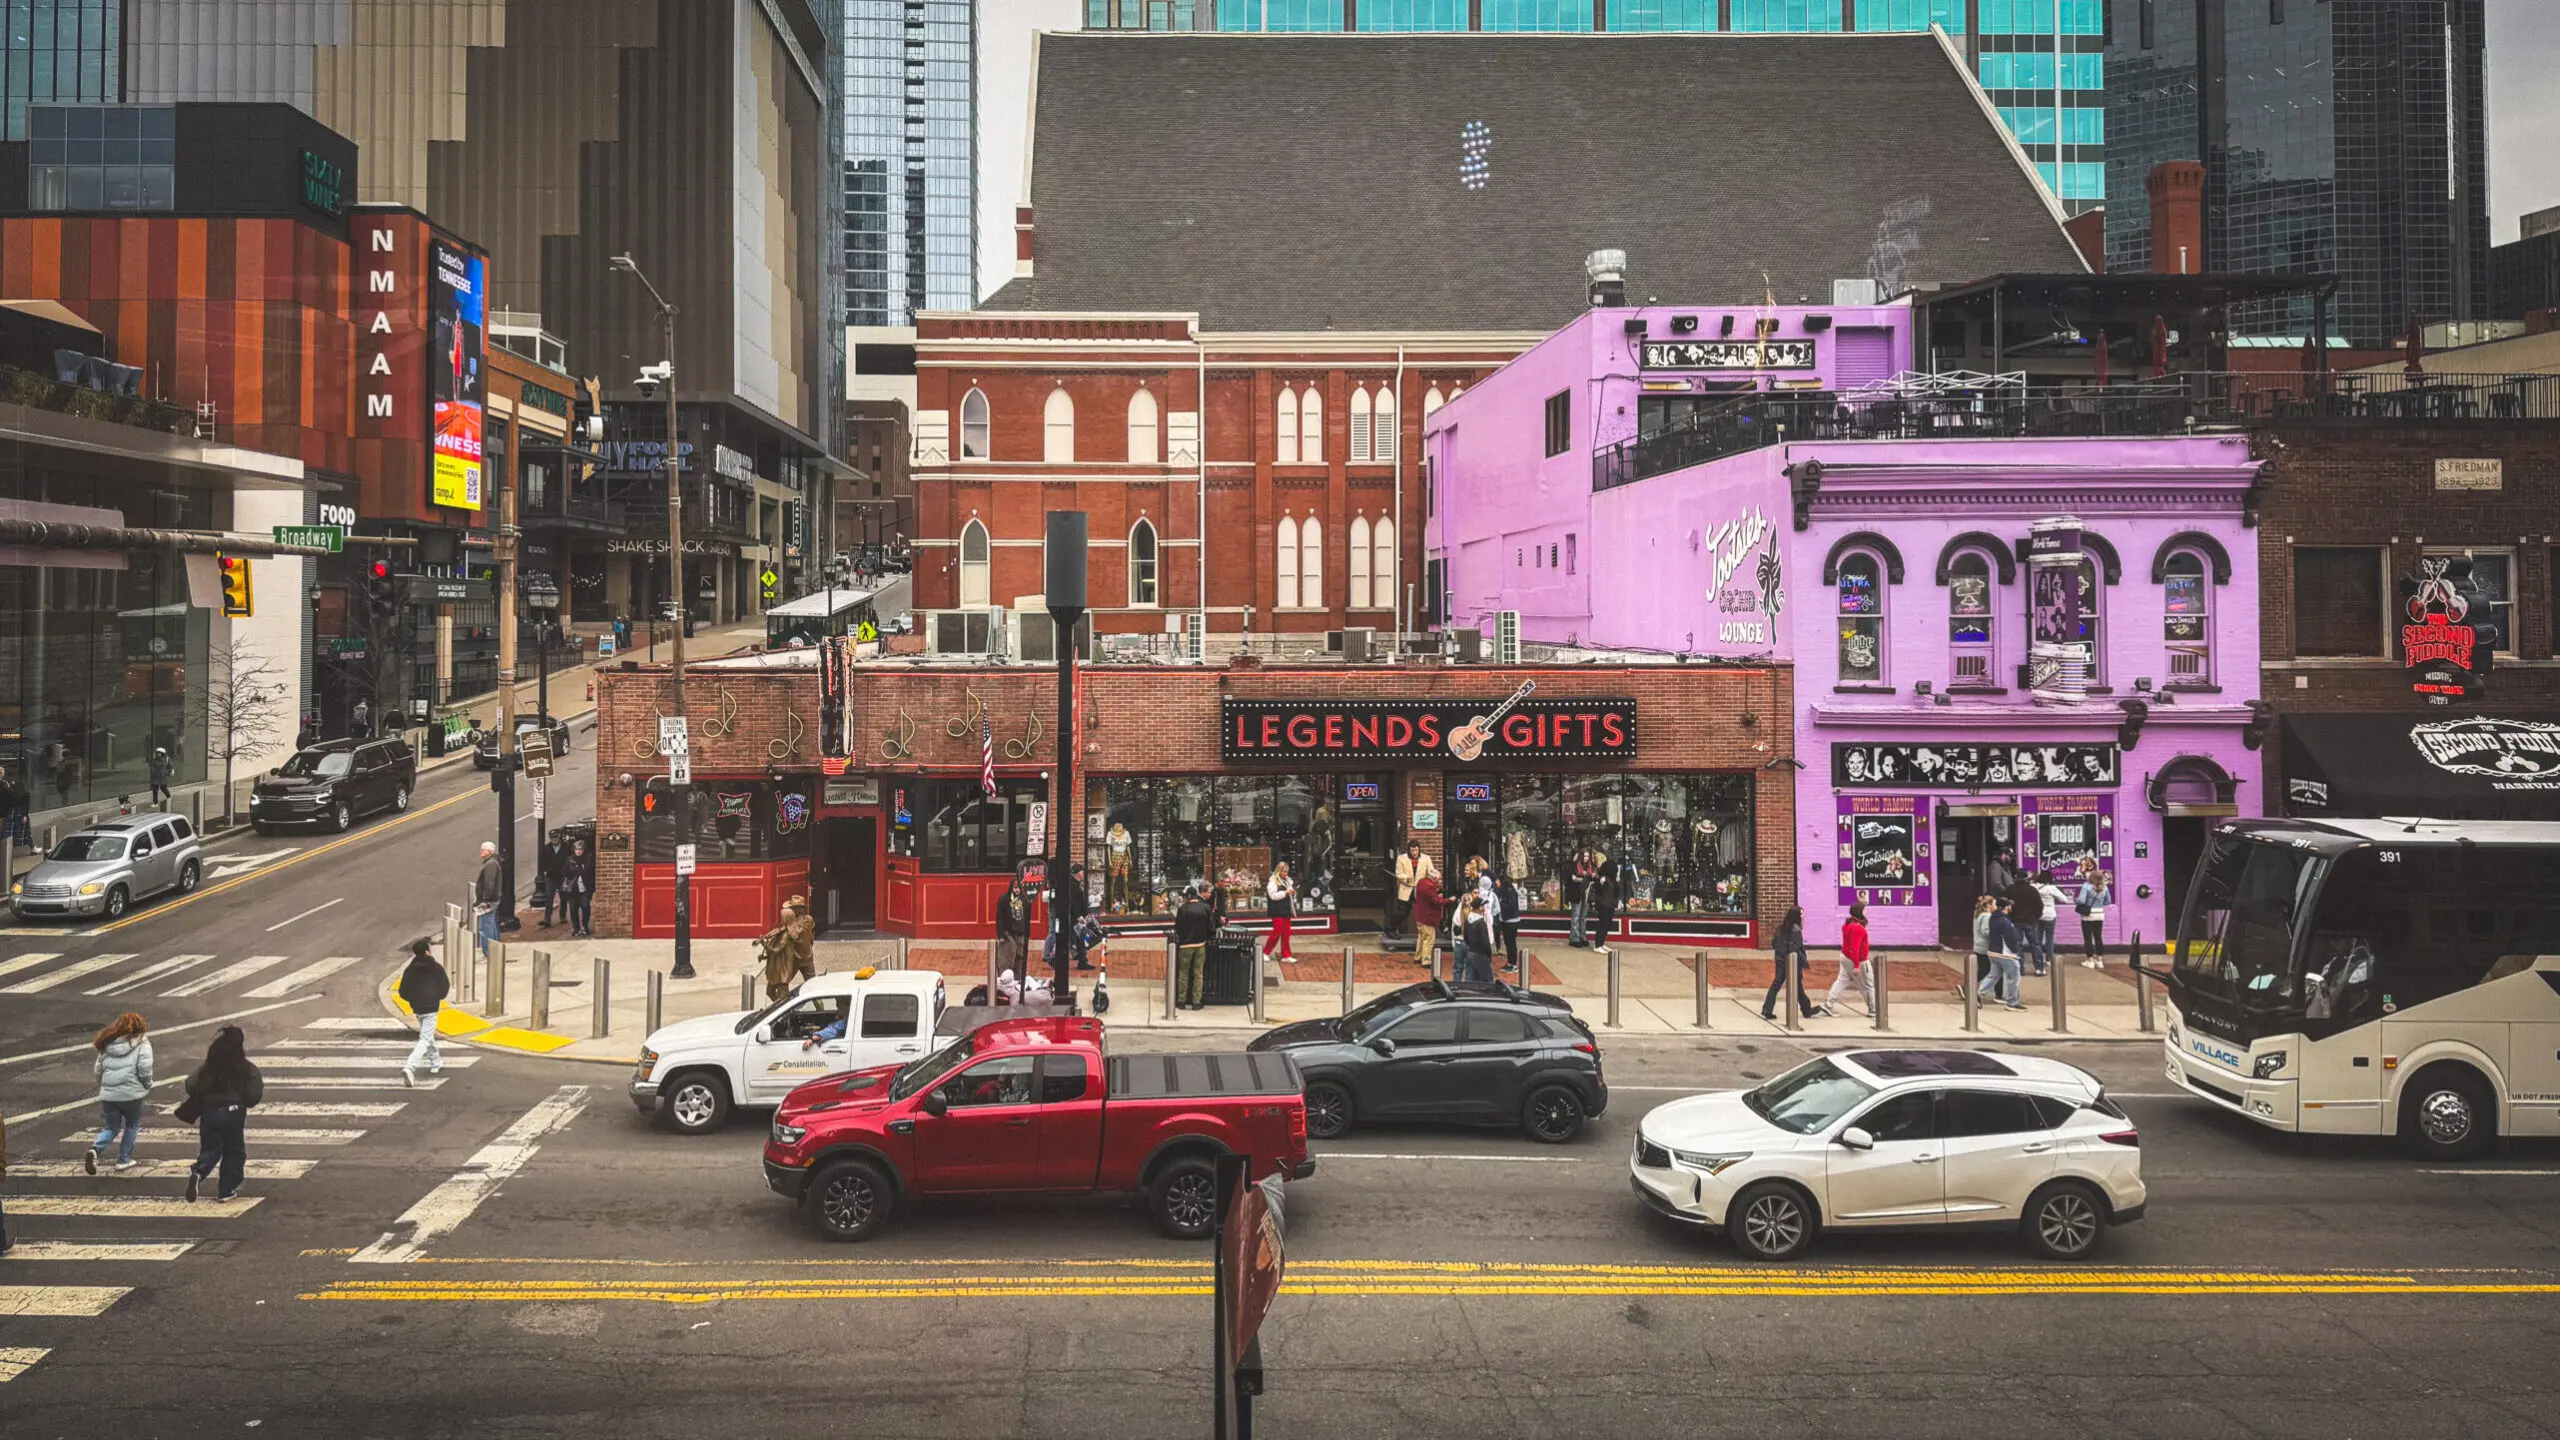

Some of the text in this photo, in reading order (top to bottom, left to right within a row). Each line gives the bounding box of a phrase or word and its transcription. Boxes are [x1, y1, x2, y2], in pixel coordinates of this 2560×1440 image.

[438, 247, 457, 269] Trusted
[438, 266, 472, 295] TENNESSEE
[367, 229, 395, 417] NMAAM
[629, 456, 693, 471] HAL
[320, 503, 356, 526] FOOD
[280, 527, 334, 551] Broadway
[607, 540, 653, 553] SHAKE
[1840, 579, 1871, 588] ULTRA
[1720, 590, 1756, 615] ORCHID
[2426, 612, 2448, 626] THE
[1720, 621, 1765, 645] LOUNGE
[2401, 624, 2475, 649] SECOND
[2405, 643, 2473, 671] FIDDLE
[663, 726, 685, 734] CROSSING
[1237, 712, 1624, 748] LEGENDS GIFTS
[662, 736, 673, 751] OK
[2423, 733, 2501, 763] SECOND
[1349, 787, 1376, 797] OPEN
[1459, 787, 1487, 798] OPEN
[1853, 797, 1914, 812] WORLD FAMOUS
[2037, 796, 2098, 810] WORLD FAMOUS
[2221, 825, 2237, 834] 391
[2292, 839, 2311, 848] 391
[1856, 848, 1894, 869] Tootsies
[2041, 848, 2086, 870] Tootsies
[2380, 852, 2401, 863] 391
[2191, 1011, 2239, 1032] PREVOST
[2191, 1038, 2240, 1068] VILLAGE
